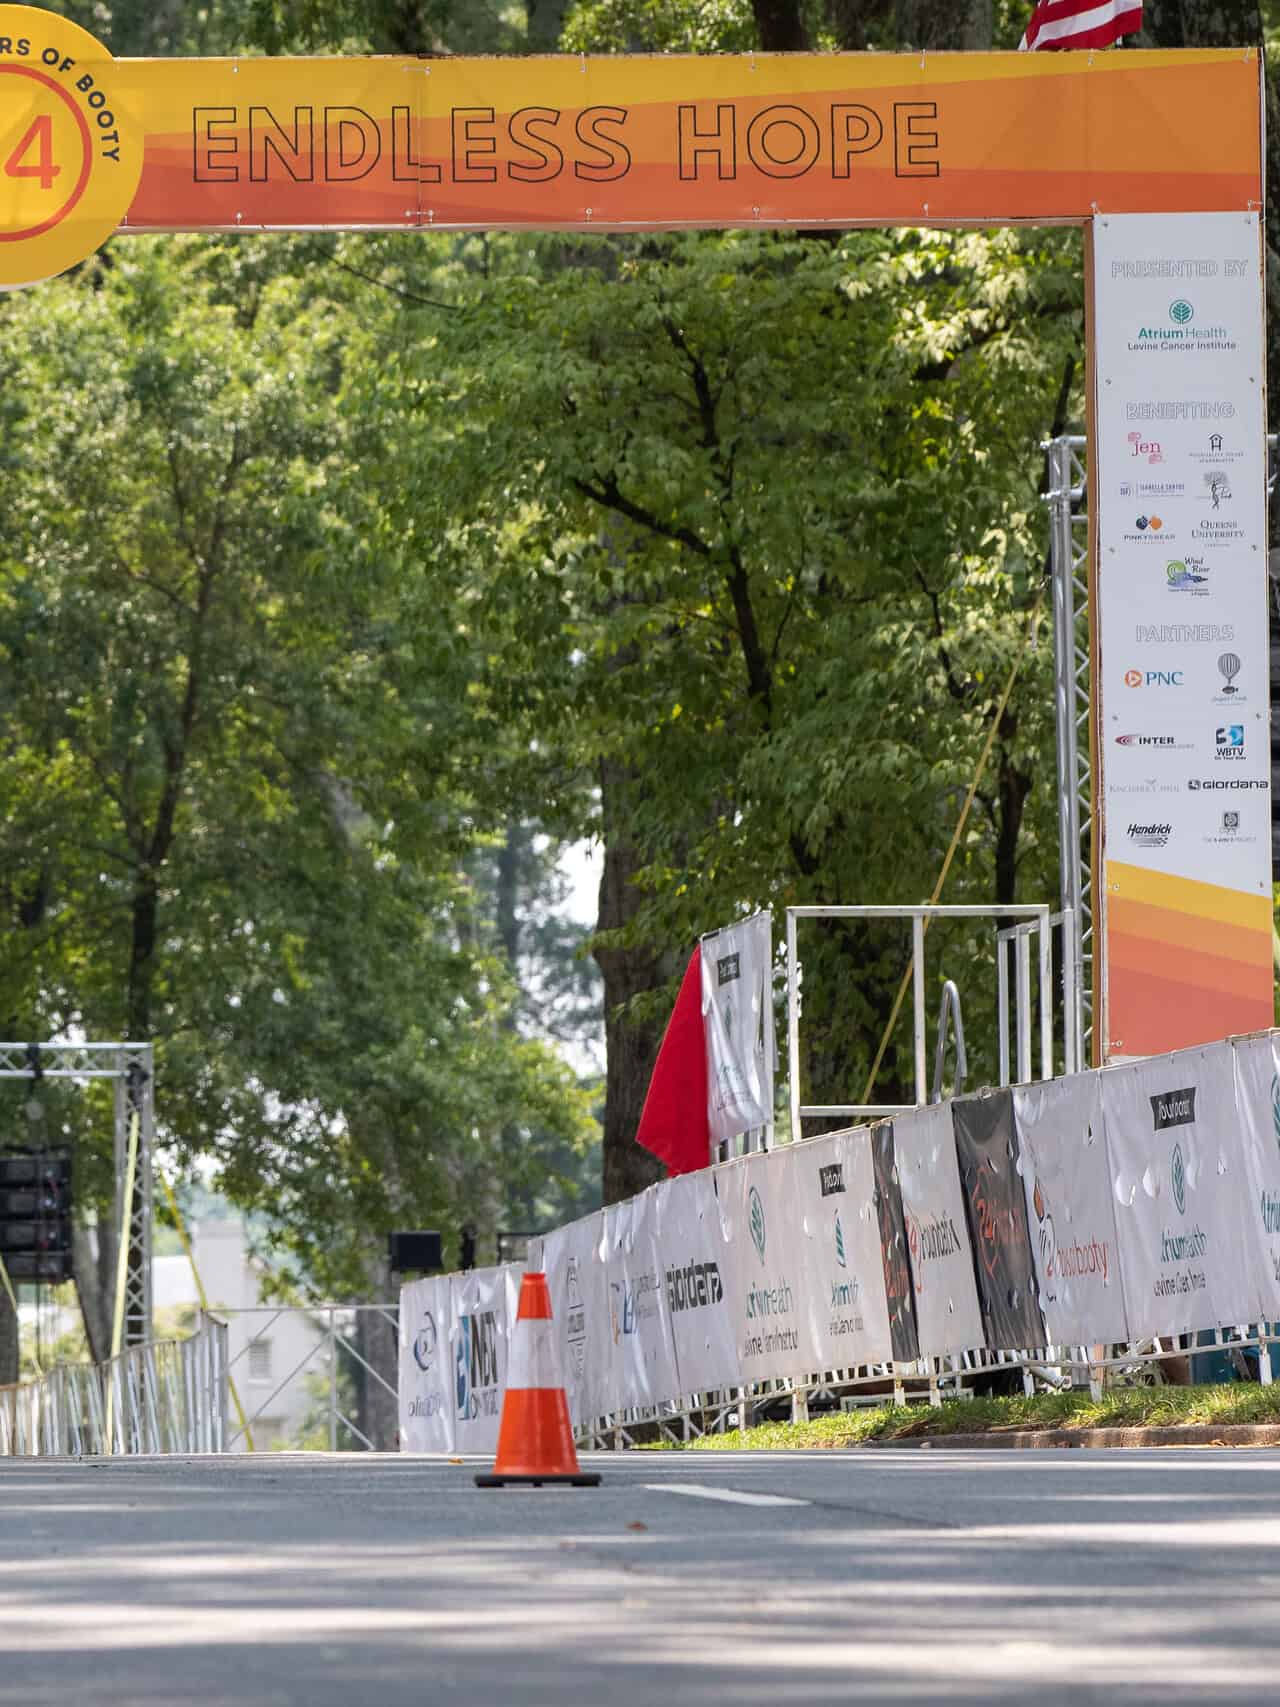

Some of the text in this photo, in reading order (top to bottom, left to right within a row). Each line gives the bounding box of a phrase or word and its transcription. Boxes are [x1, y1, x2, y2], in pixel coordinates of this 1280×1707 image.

[41, 48, 75, 72] OF
[75, 74, 120, 162] BOOTY
[192, 105, 633, 184] ENDLESS
[677, 102, 941, 181] HOPE
[1111, 259, 1249, 279] PRESENTED BY
[1138, 327, 1227, 339] Atrium Health
[1127, 341, 1237, 351] Levine Cancer Institute
[1135, 624, 1234, 642] PARTNERS
[1146, 671, 1184, 686] PNC
[1139, 736, 1174, 745] INTER
[1217, 747, 1244, 757] WBTV
[1127, 823, 1172, 837] Hendrick
